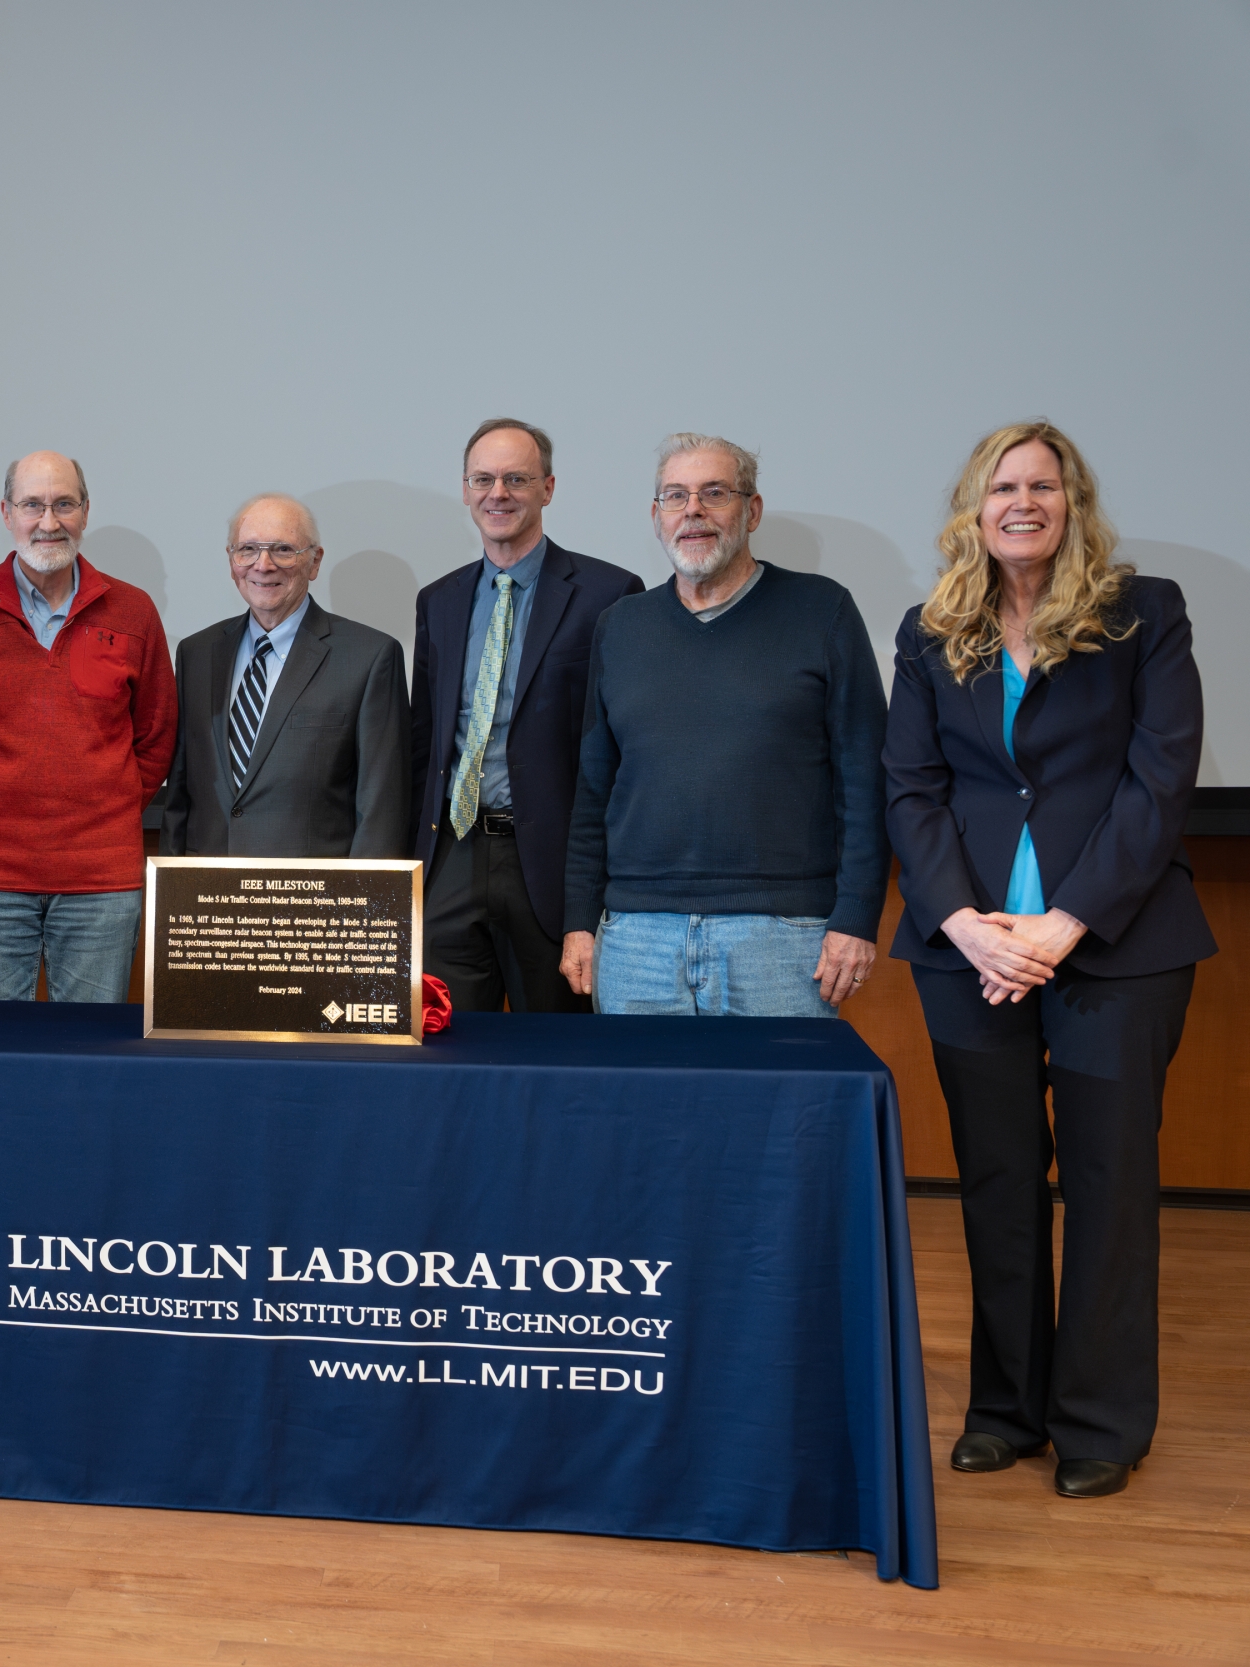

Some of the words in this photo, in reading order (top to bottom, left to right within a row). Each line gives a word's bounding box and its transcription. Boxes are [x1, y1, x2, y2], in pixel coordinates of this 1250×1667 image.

[240, 880, 263, 889] IEEE
[266, 880, 325, 890] MILESTONE
[314, 897, 336, 906] System,
[237, 916, 269, 926] Laboratory
[272, 917, 290, 926] began
[294, 918, 326, 927] developing
[169, 928, 197, 936] secondary
[168, 939, 182, 947] busy,
[241, 940, 265, 949] airspace.
[280, 941, 310, 950] technology
[186, 951, 212, 959] spectrum
[230, 952, 254, 960] previous
[284, 953, 292, 961] By
[352, 954, 382, 963] techniques
[258, 986, 286, 996] February
[345, 1004, 397, 1023] IEEE
[8, 1234, 249, 1280] LINCOLN
[268, 1246, 672, 1298] LABORATORY
